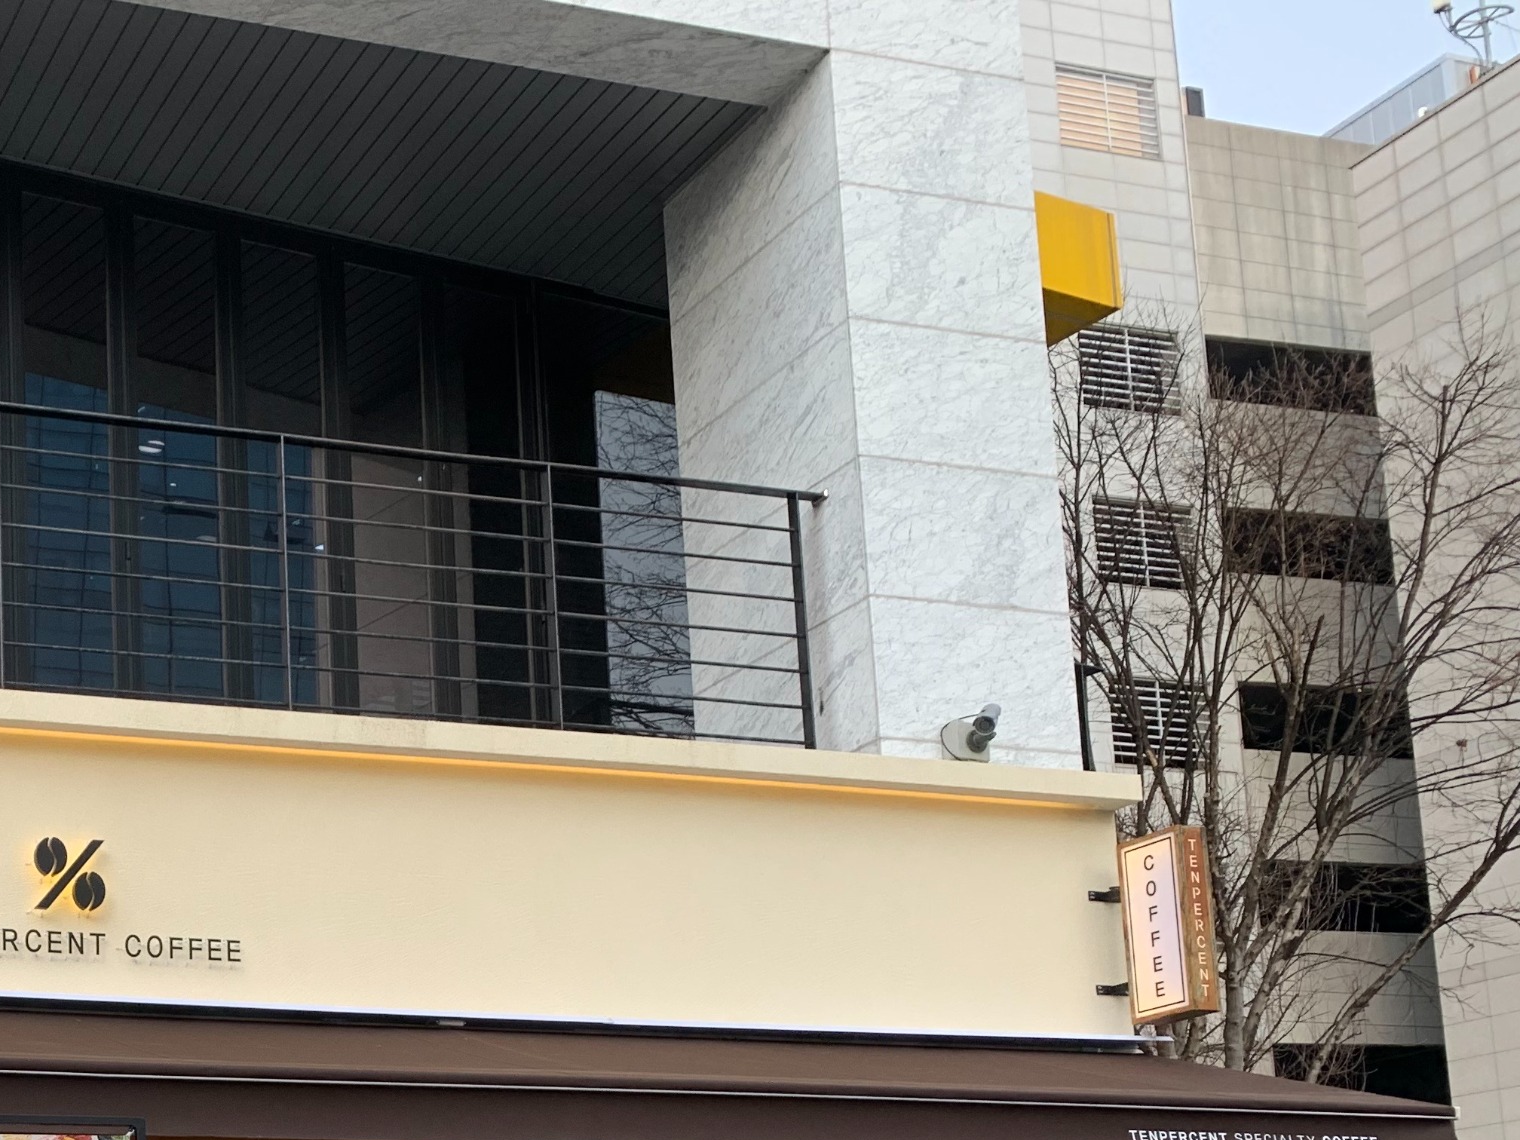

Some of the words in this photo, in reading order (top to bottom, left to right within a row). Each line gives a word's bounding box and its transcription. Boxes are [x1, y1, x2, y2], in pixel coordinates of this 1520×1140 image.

[124, 934, 242, 963] COFFEE
[1143, 854, 1166, 998] COFFEE
[1187, 838, 1210, 997] TENPERCENT
